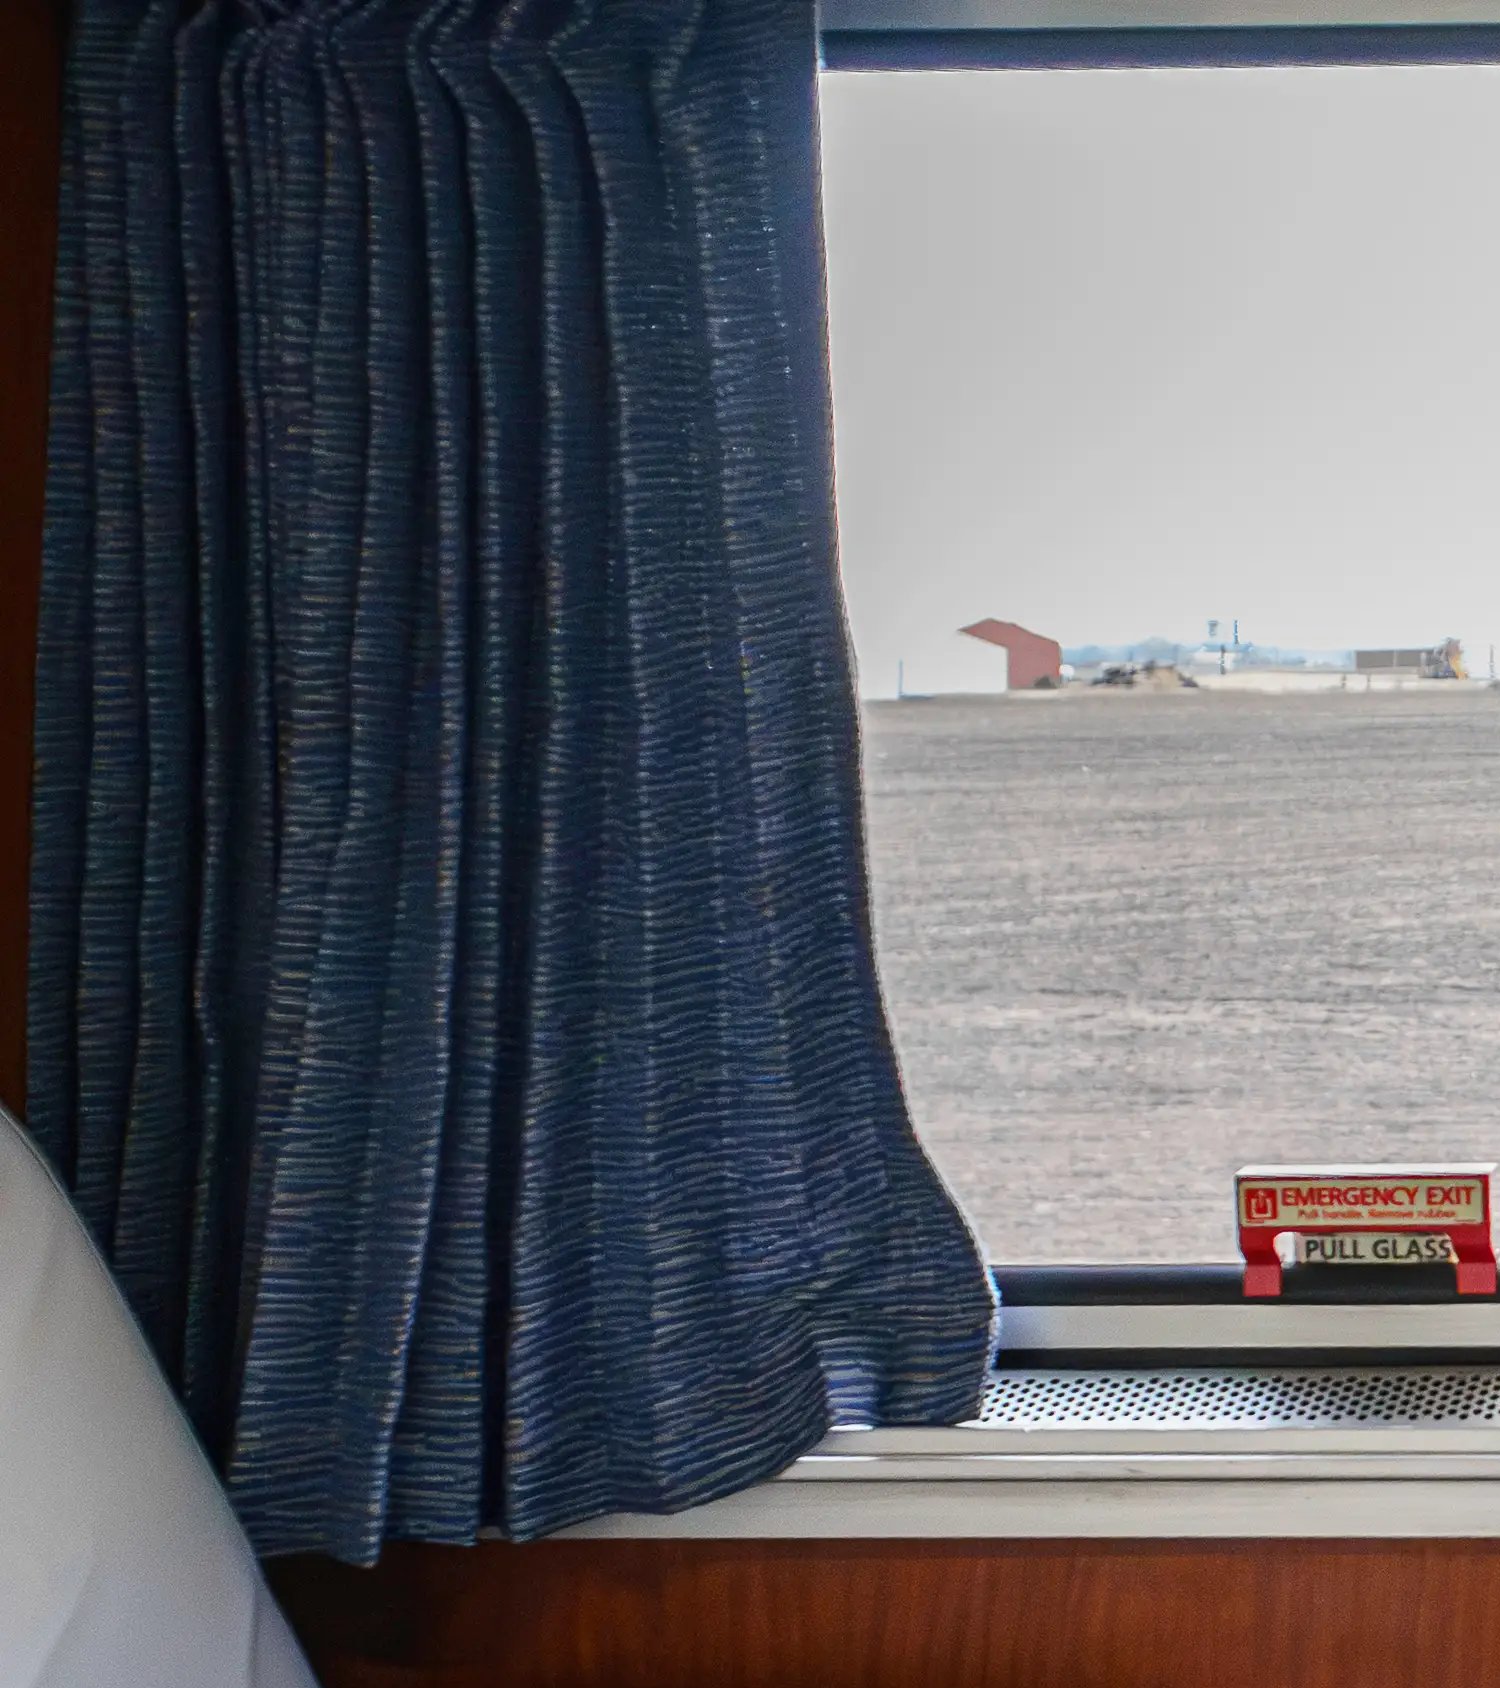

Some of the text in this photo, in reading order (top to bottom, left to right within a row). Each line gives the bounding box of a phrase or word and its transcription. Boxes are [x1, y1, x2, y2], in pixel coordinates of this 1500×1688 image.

[1281, 1185, 1475, 1207] EMERGENCY EXIT
[1304, 1238, 1451, 1260] PULL GLASS
